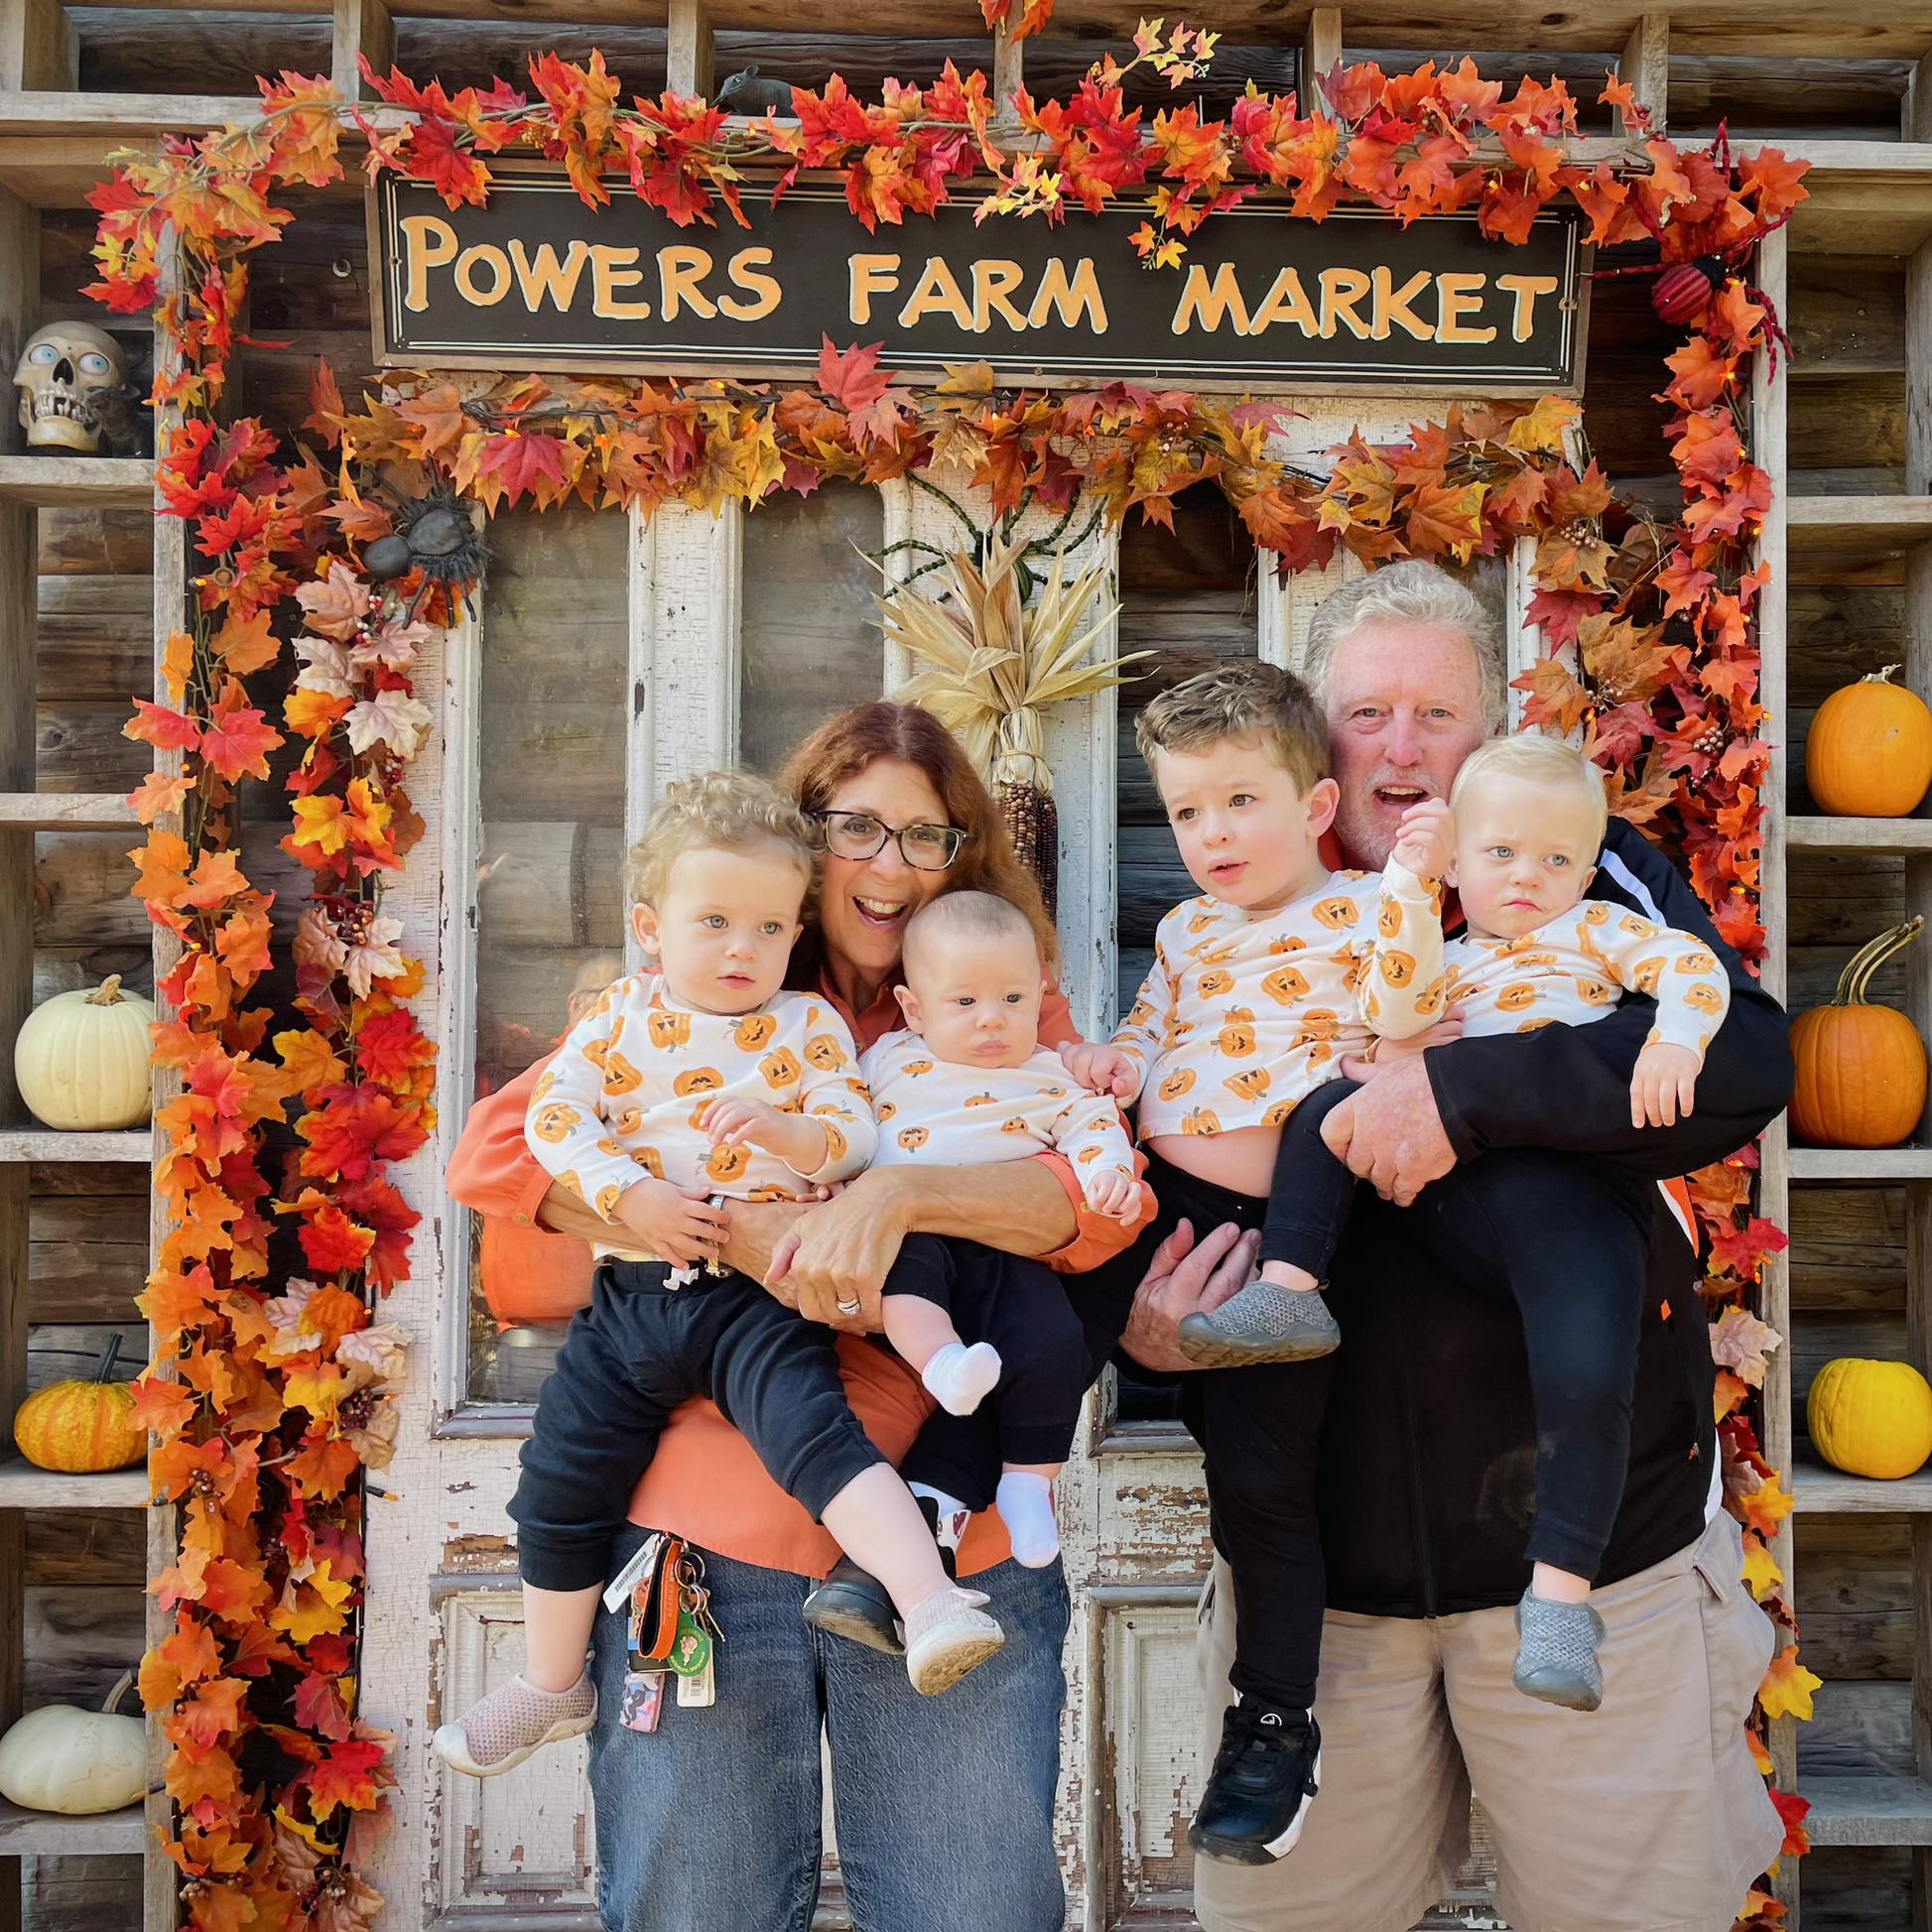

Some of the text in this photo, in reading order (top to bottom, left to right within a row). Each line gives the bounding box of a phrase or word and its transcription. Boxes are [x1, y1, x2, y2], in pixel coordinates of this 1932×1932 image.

[399, 214, 1560, 345] POWERS FARM MARKET
